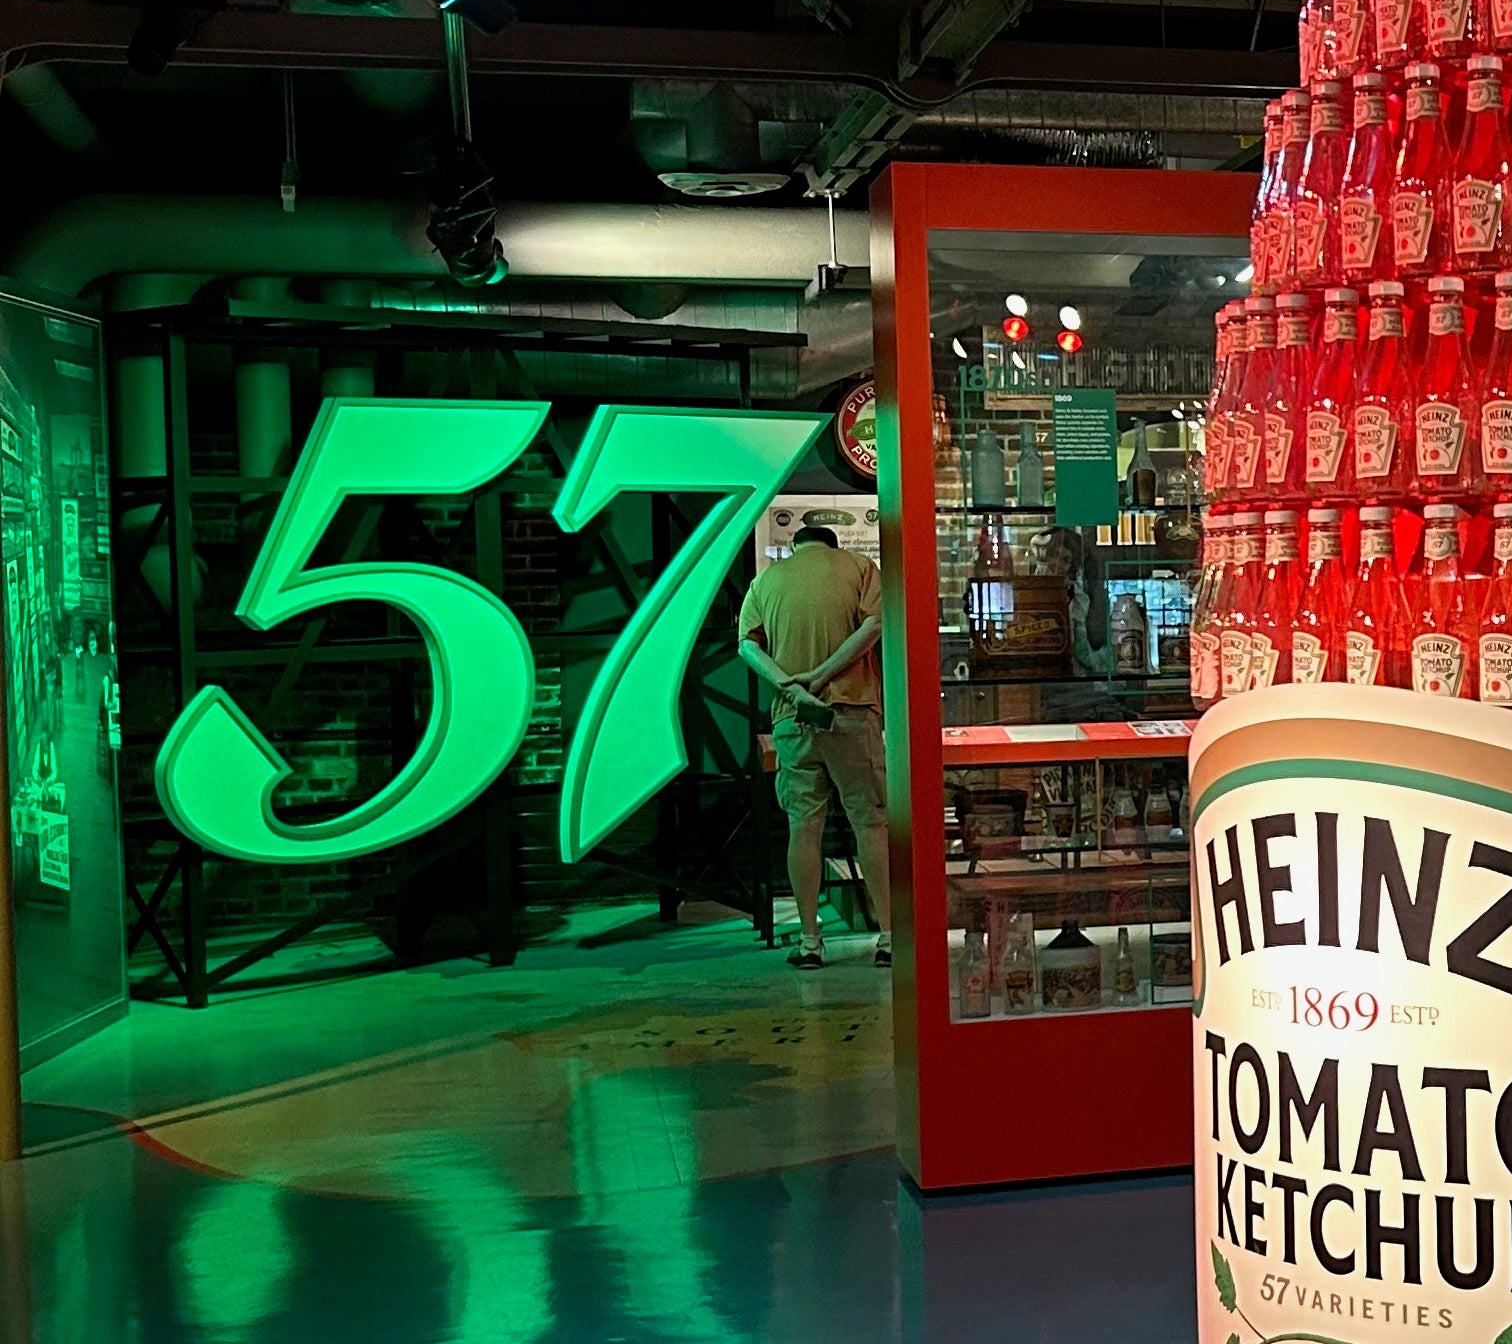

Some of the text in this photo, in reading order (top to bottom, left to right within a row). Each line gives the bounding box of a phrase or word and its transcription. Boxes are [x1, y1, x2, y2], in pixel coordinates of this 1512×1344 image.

[848, 385, 876, 413] PUR
[154, 396, 836, 864] 57
[1289, 986, 1379, 1032] 1869
[1260, 1273, 1454, 1330] 57 VARIETIES
